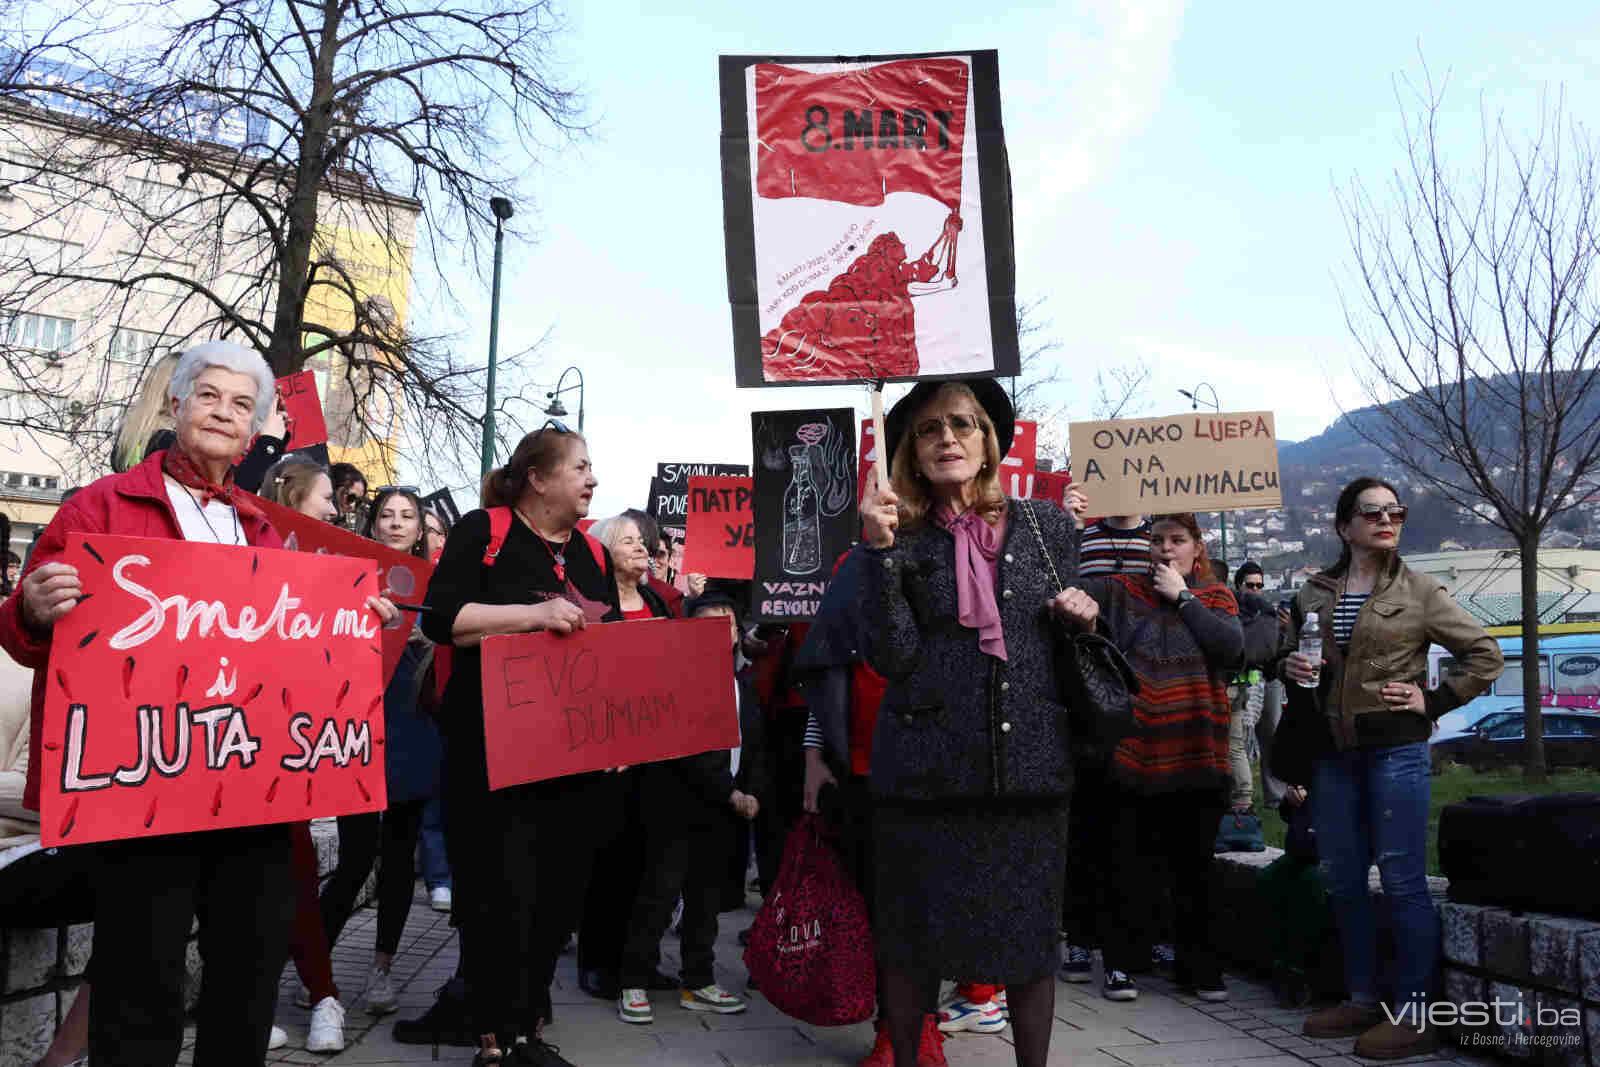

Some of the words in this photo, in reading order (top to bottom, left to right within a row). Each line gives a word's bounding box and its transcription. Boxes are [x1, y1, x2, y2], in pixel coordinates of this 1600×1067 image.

[801, 104, 953, 152] 8.MART
[1094, 424, 1182, 449] OVAKO
[1084, 458, 1105, 482] A
[1123, 455, 1164, 475] NA
[1140, 470, 1278, 497] MINIMALCU
[692, 487, 752, 512] ПАТР
[109, 554, 326, 649] Smeta
[332, 602, 377, 638] mi
[206, 657, 237, 698] i
[502, 648, 598, 708] EVO
[61, 703, 261, 792] LJUTA
[280, 712, 372, 773] SAM
